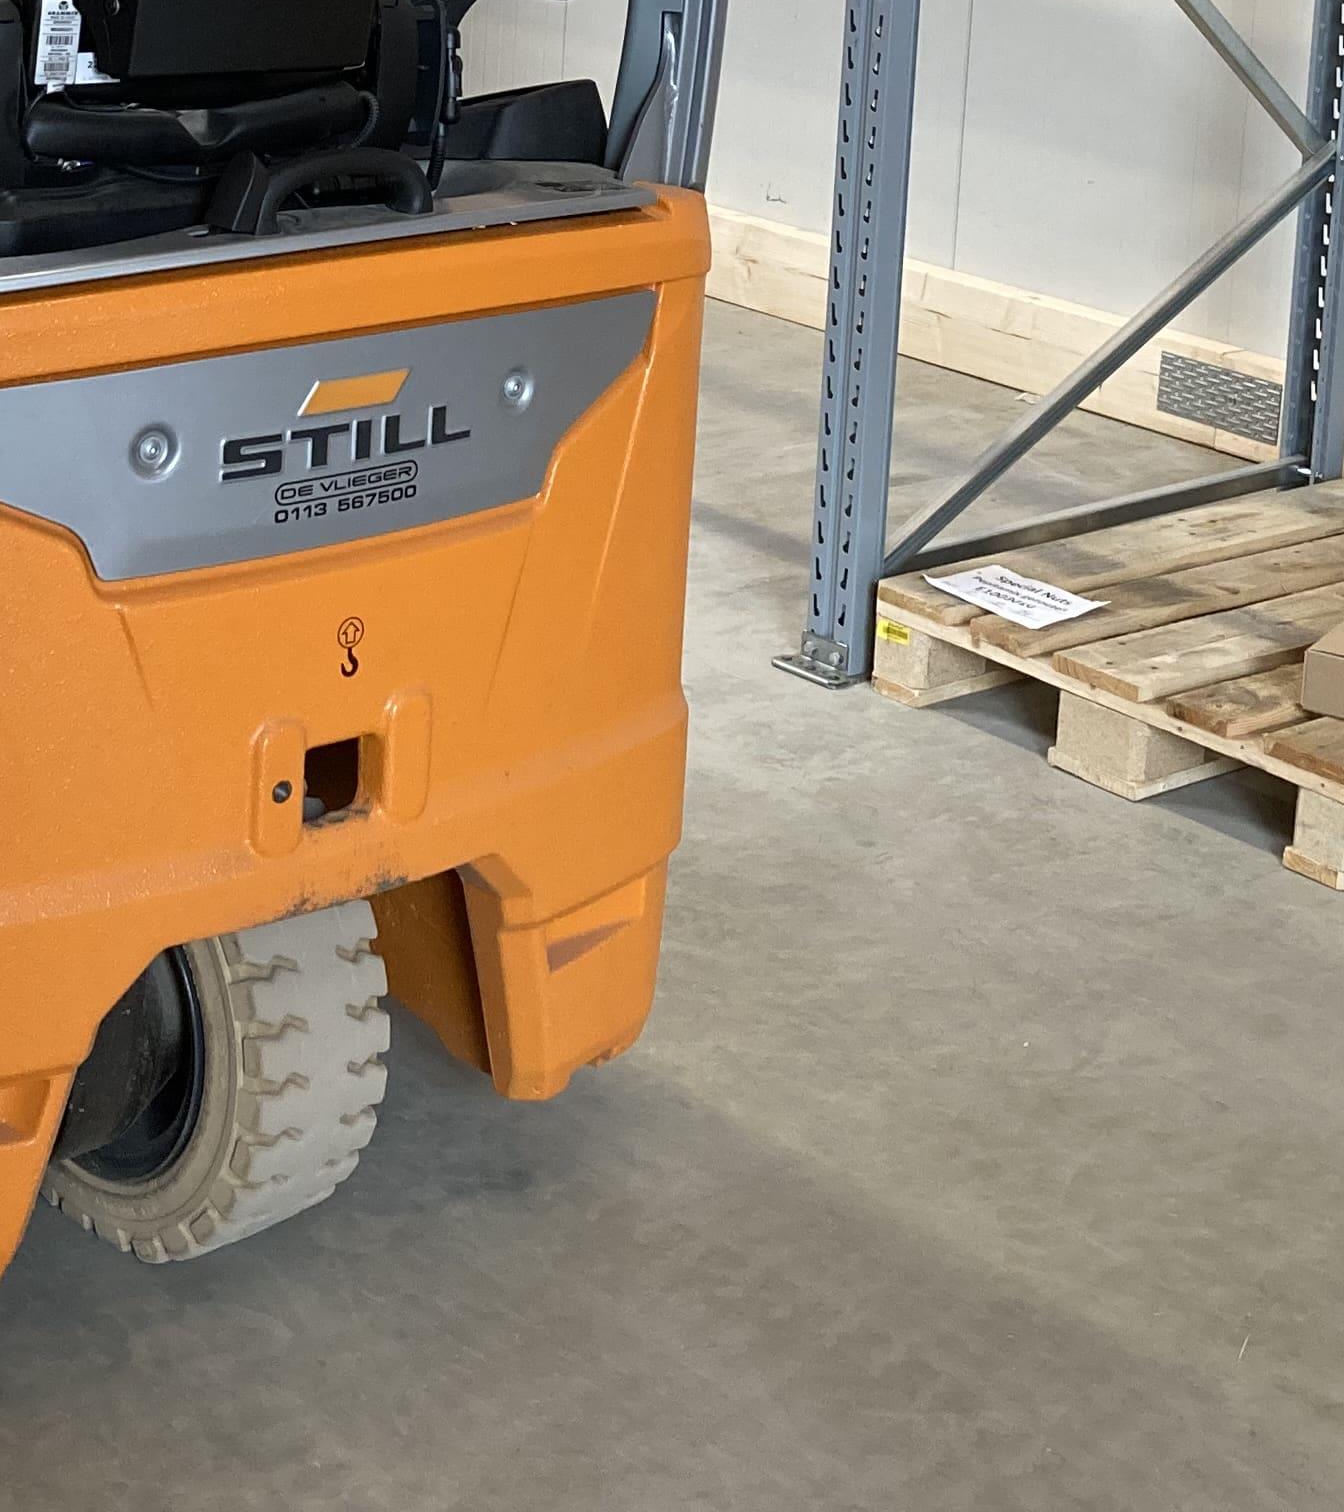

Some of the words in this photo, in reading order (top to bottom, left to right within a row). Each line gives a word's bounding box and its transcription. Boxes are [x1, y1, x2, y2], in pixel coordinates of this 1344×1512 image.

[219, 405, 471, 484] STILL
[280, 485, 314, 501] DE
[319, 465, 413, 494] VLIEGER
[273, 503, 328, 524] 0113
[337, 484, 417, 513] 567500
